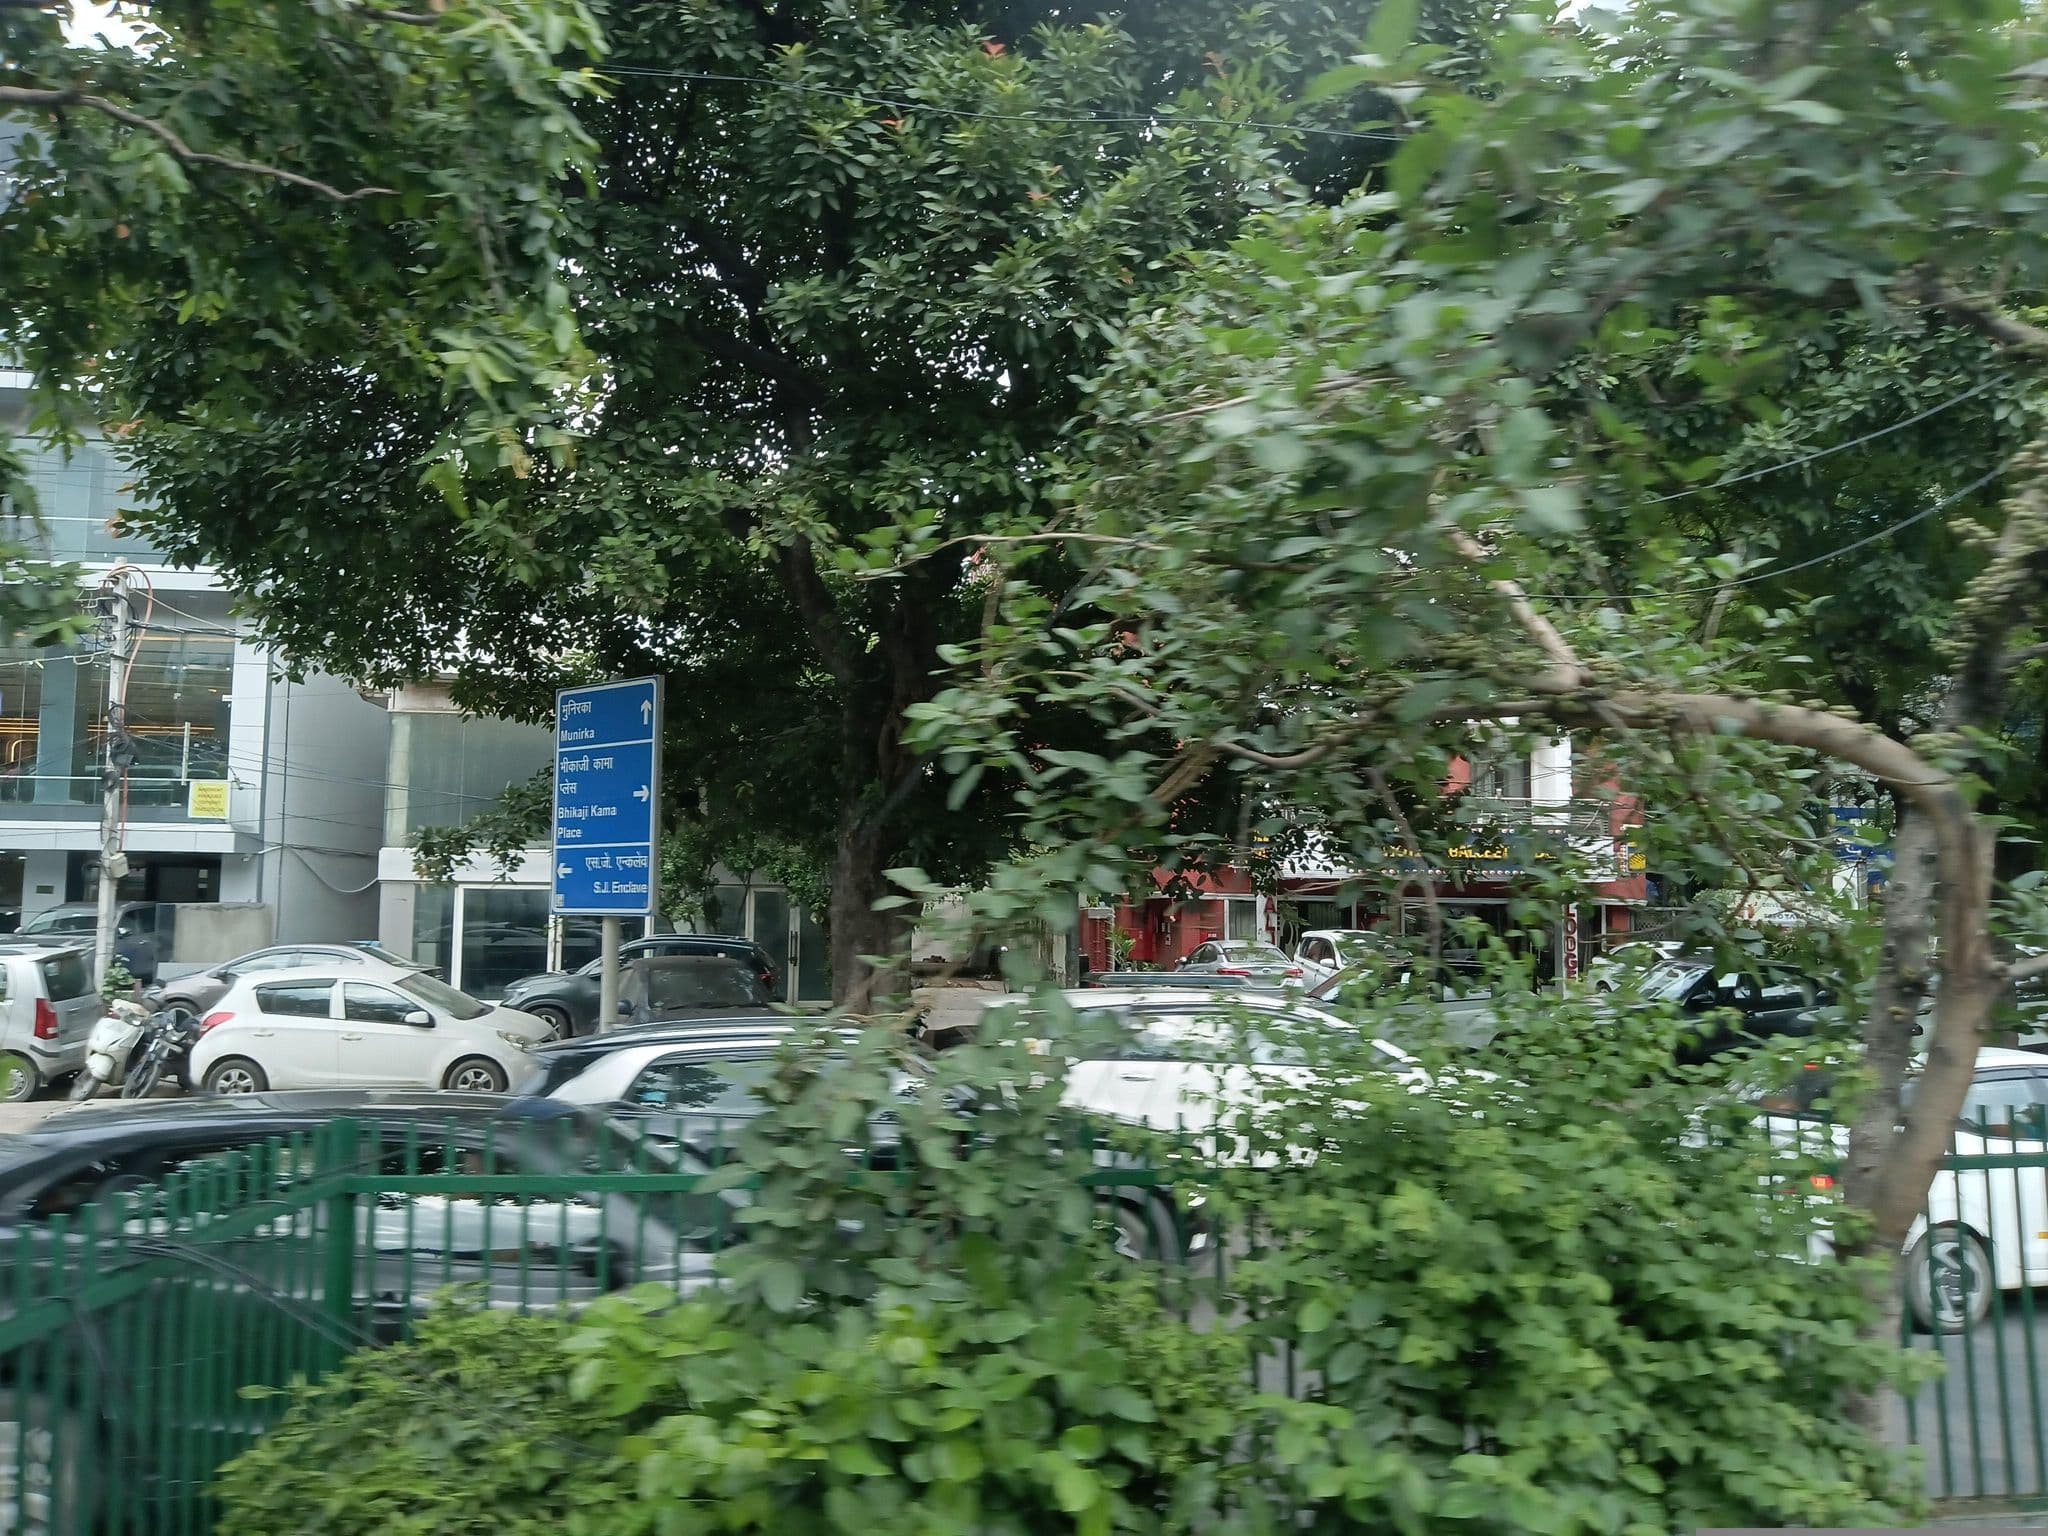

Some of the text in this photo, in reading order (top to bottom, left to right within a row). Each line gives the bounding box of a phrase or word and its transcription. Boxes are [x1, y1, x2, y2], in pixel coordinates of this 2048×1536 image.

[562, 700, 592, 721] मुनिरका
[560, 728, 595, 742] Munirka
[560, 755, 614, 773] भीकाजी कामा
[559, 779, 577, 795] प्लेस
[558, 805, 617, 820] Bhikaji Kama
[557, 827, 582, 838] Place
[612, 881, 647, 894] Enclave
[1564, 903, 1577, 980] LODGE
